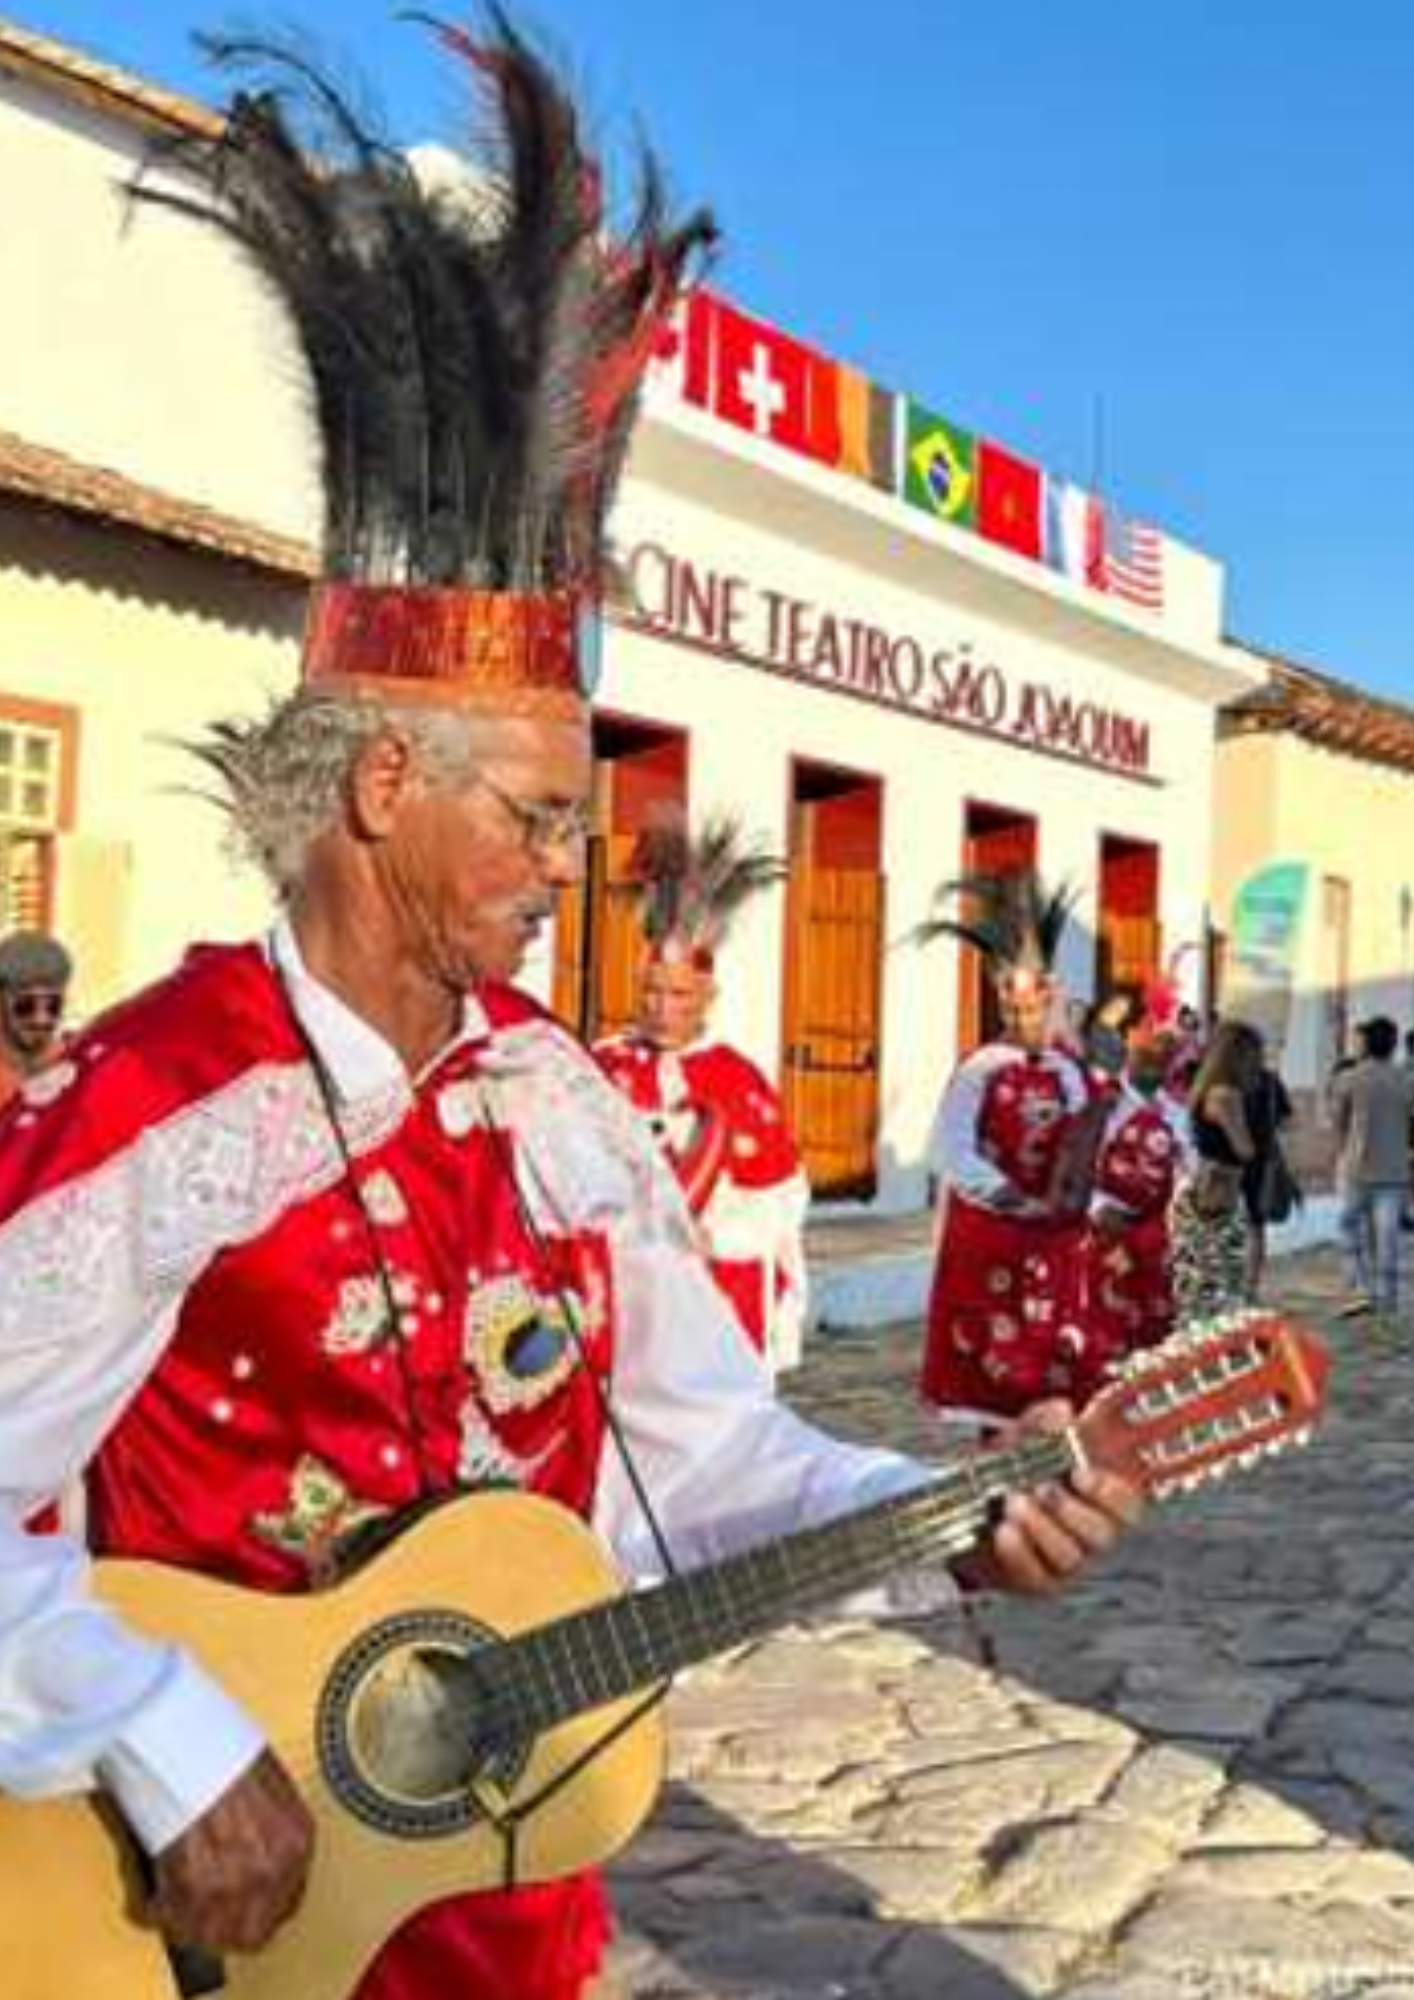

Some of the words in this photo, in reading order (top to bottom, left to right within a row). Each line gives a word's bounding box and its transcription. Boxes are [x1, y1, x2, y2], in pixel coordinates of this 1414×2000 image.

[631, 541, 748, 651] CINE
[759, 590, 923, 698] TEATRO
[932, 643, 1007, 727] SÃO
[1011, 682, 1149, 768] JOAQUIM
